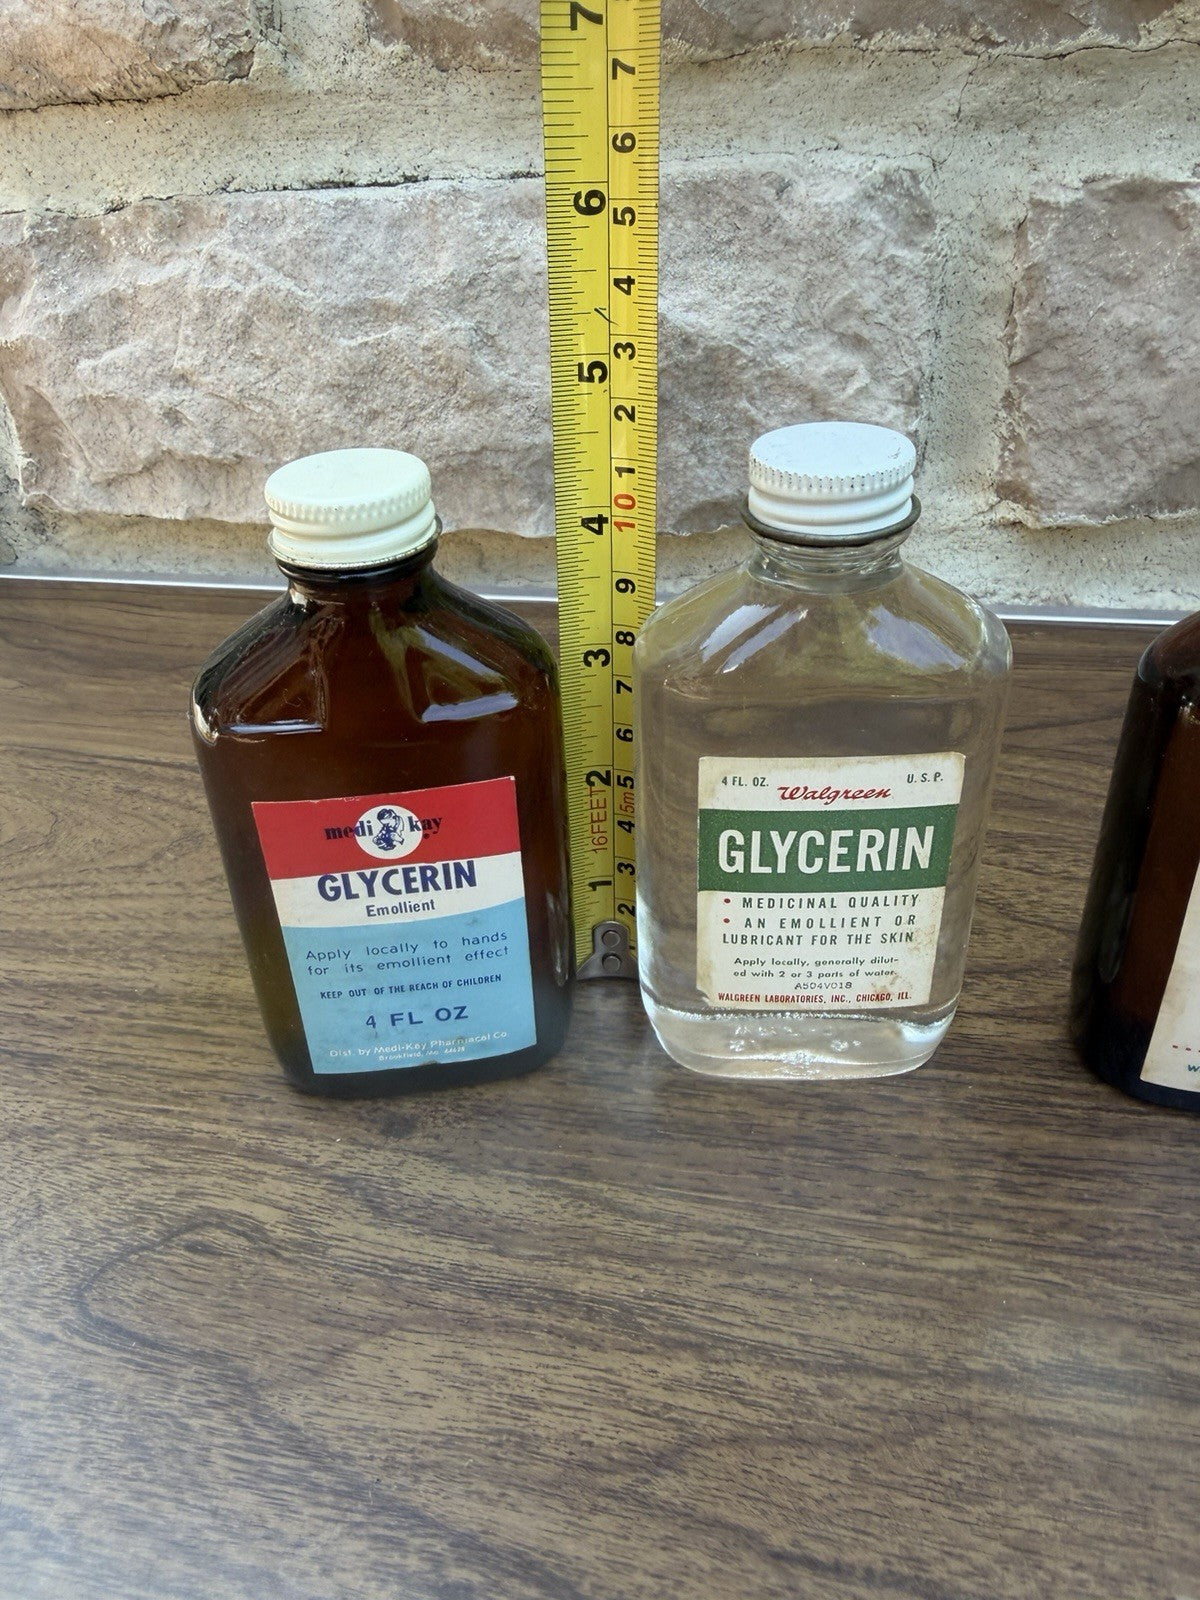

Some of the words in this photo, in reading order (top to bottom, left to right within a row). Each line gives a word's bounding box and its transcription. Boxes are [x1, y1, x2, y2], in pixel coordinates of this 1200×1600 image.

[570, 2, 603, 31] 7
[611, 58, 636, 80] 7
[612, 132, 637, 153] 6
[573, 189, 606, 216] 6
[612, 206, 636, 227] 5
[613, 275, 636, 295] 4
[613, 341, 636, 361] 3
[578, 360, 608, 384] 5
[614, 404, 636, 423] 2
[614, 465, 636, 478] 1
[580, 513, 609, 536] 4
[615, 577, 636, 594] 9
[615, 630, 636, 647] 8
[583, 648, 611, 668] 3
[616, 679, 633, 694] 7
[615, 728, 634, 743] 6
[585, 769, 612, 787] 2
[616, 774, 635, 790] 5
[722, 776, 728, 786] 4
[732, 776, 748, 787] FL.
[752, 777, 769, 787] OZ.
[777, 785, 892, 806] Walgreen
[324, 820, 374, 840] medi
[408, 816, 443, 835] kay
[617, 820, 635, 834] 4
[718, 825, 935, 874] GLYCERIN
[617, 862, 636, 876] 3
[317, 859, 478, 902] GLYCERIN
[588, 880, 612, 892] 1
[366, 899, 436, 918] Emollient
[617, 903, 635, 917] 2
[742, 897, 837, 909] MEDICINAL
[849, 894, 919, 908] QUALITY
[744, 917, 766, 929] AN
[780, 916, 881, 929] EMOLLIENT
[895, 915, 917, 927] OR
[306, 949, 351, 961] Apply
[366, 943, 419, 956] locally
[433, 940, 448, 949] to
[462, 932, 508, 946] hands
[723, 933, 803, 946] LUBRICANT
[811, 934, 838, 946] FOR
[847, 934, 872, 945] THE
[880, 932, 914, 944] SKIN
[307, 965, 329, 975] for
[345, 963, 364, 973] its
[377, 955, 451, 971] emollient
[465, 946, 508, 961] effect
[734, 957, 766, 967] Apply
[771, 958, 809, 967] locally,
[815, 957, 866, 967] generally
[871, 956, 899, 965] dilut-
[733, 969, 747, 977] ed
[751, 970, 774, 978] with
[818, 971, 844, 979] parts
[849, 969, 860, 978] of
[864, 969, 897, 977] water.
[320, 990, 343, 999] KEEP
[348, 988, 367, 998] OUT
[373, 986, 385, 996] OF
[389, 985, 406, 994] THE
[409, 982, 439, 992] REACH
[442, 979, 453, 989] OF
[456, 973, 502, 988] CHILDREN
[718, 993, 761, 1003] WALGREEN
[765, 994, 827, 1004] LABORATORIES,
[856, 992, 893, 1002] CHICAGO,
[897, 991, 912, 1000] ILL.
[365, 1015, 377, 1029] 4
[390, 1011, 424, 1027] FL
[434, 1005, 469, 1022] OZ
[358, 1048, 372, 1056] by
